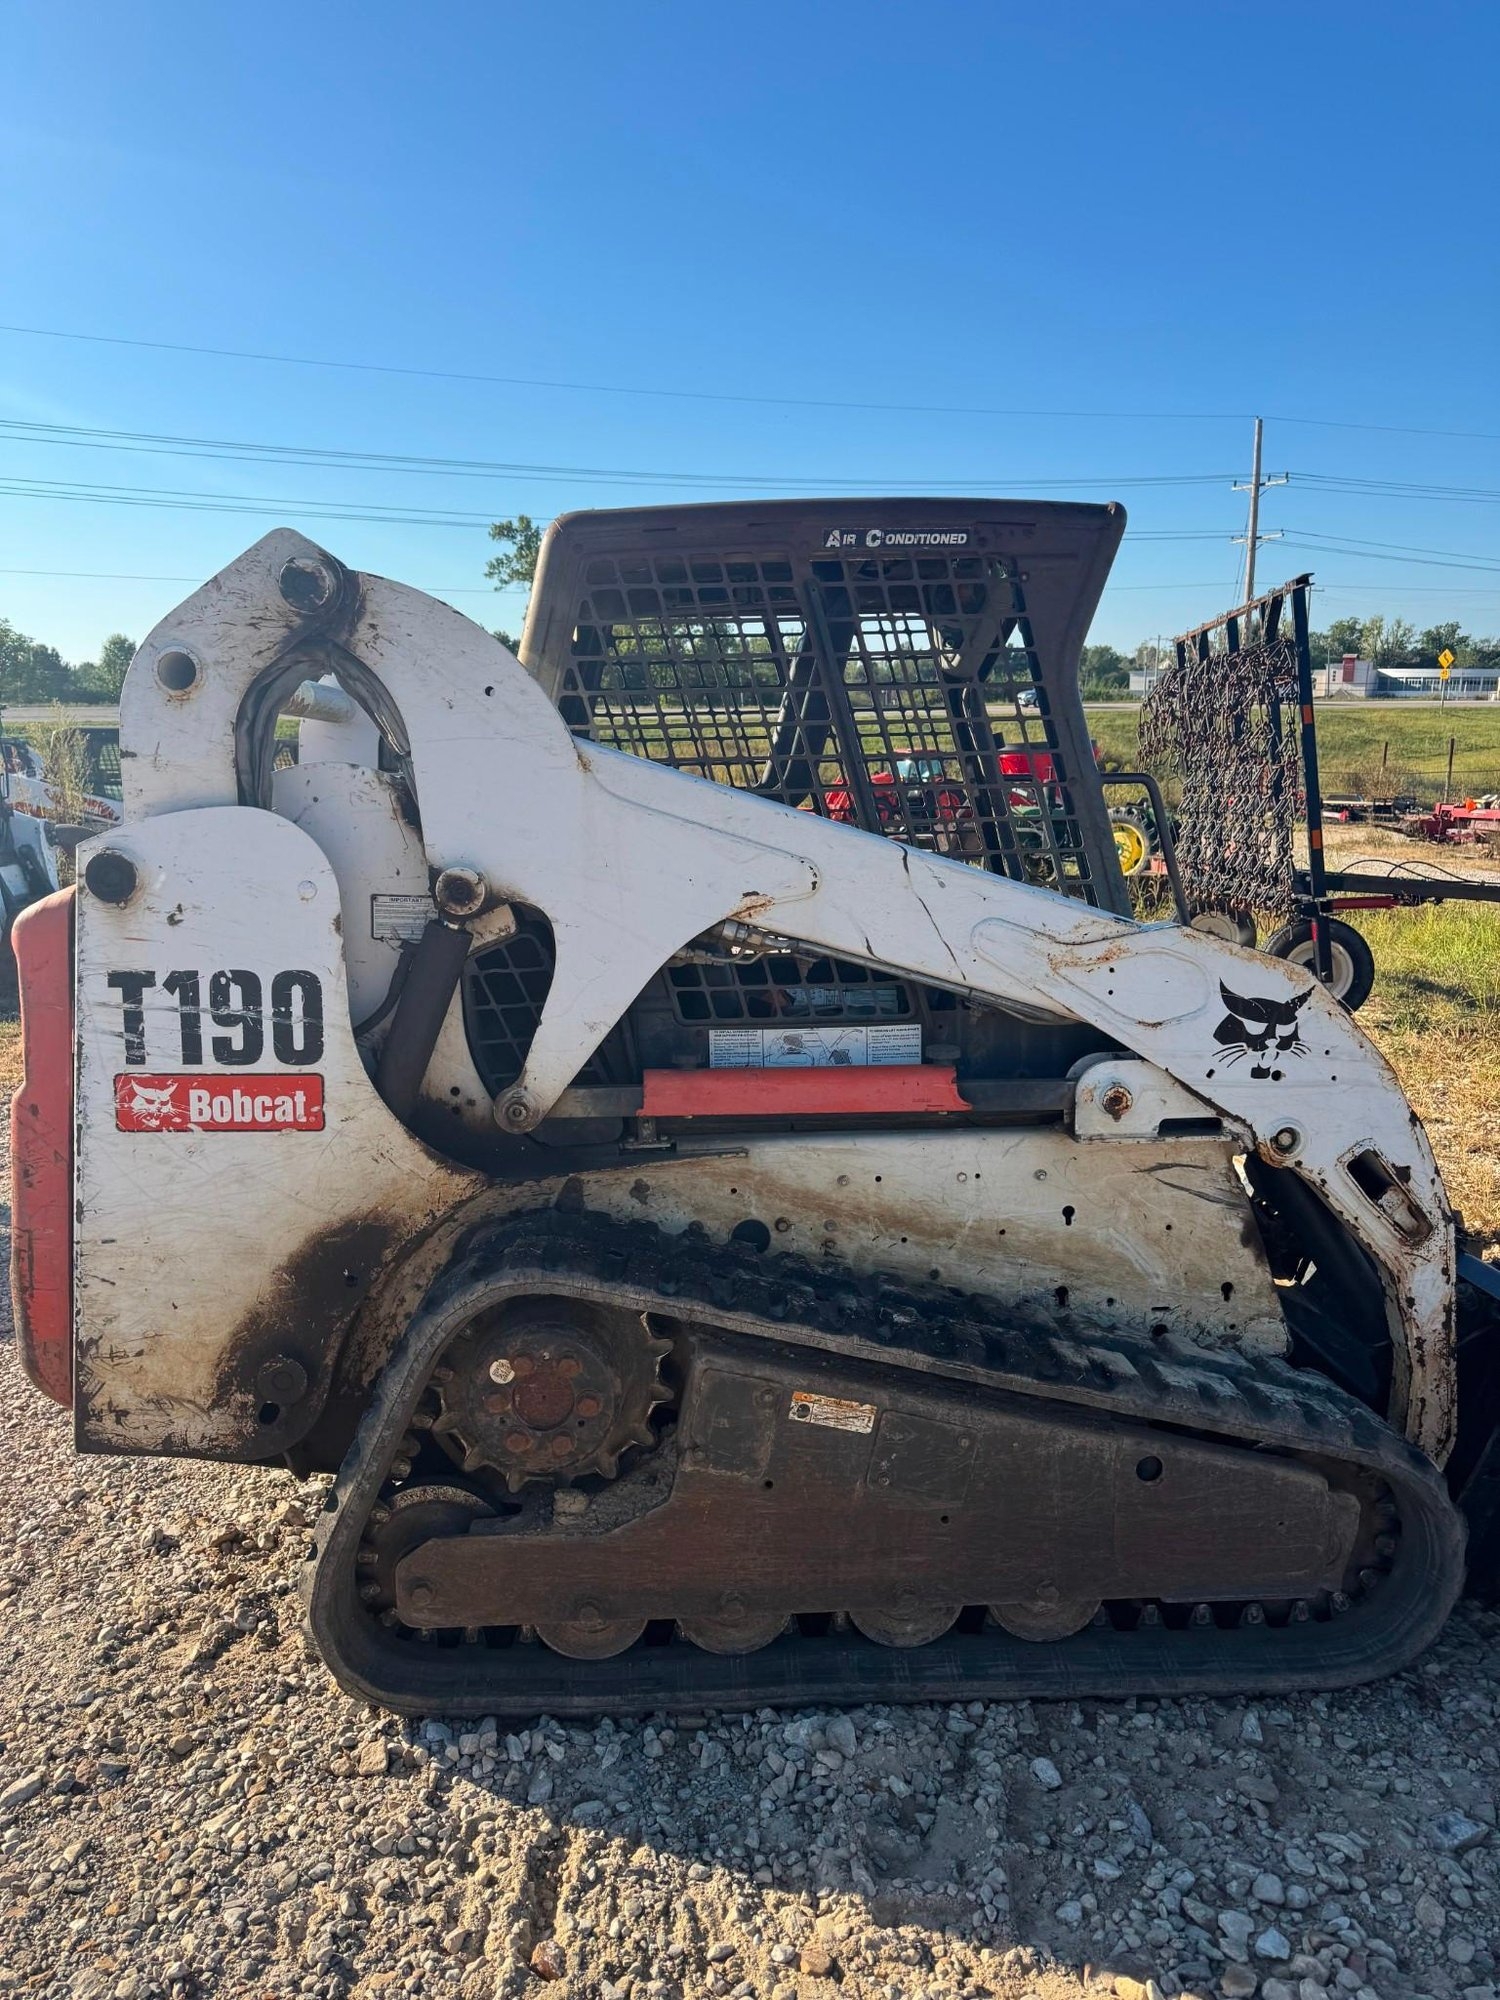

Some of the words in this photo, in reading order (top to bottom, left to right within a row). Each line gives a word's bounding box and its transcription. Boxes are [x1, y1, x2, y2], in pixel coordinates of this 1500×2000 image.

[825, 529, 857, 548] AIR
[865, 529, 968, 548] CONDITIONED
[107, 969, 325, 1066] T190
[188, 1088, 308, 1124] Bobcat
